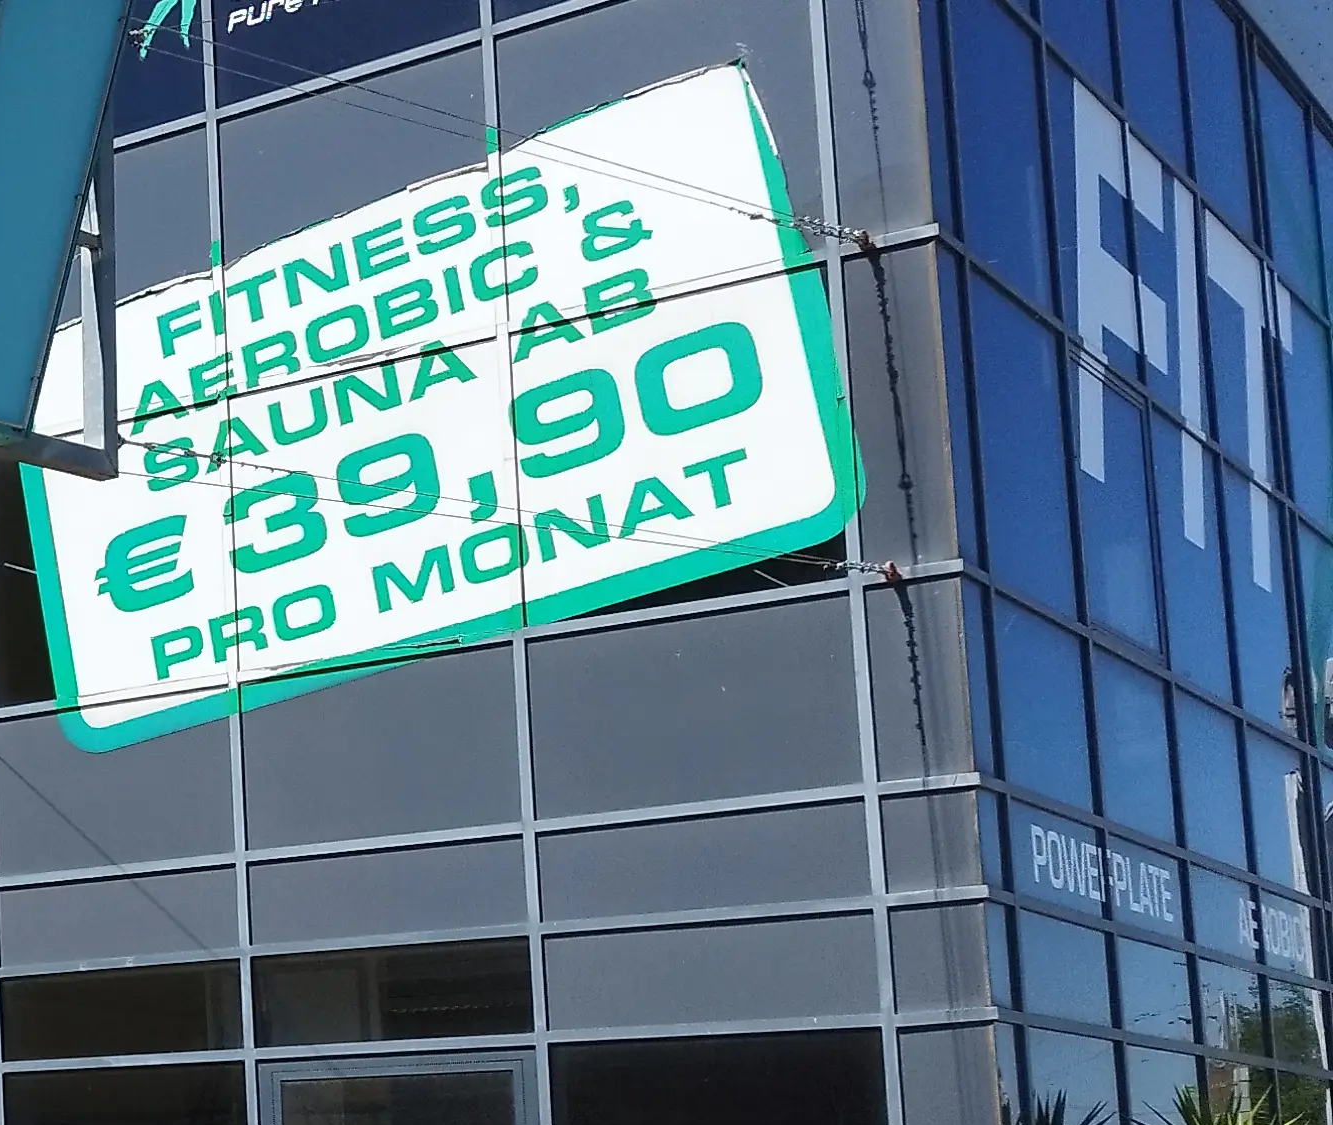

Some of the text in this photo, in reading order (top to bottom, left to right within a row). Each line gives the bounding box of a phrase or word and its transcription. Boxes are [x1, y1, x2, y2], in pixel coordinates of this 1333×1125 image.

[130, 200, 652, 436] AEROBIC &
[157, 165, 583, 358] FITNESS,
[1073, 76, 1293, 594] FIT
[94, 321, 763, 613] € 39,90
[145, 268, 657, 493] SAUNA AB
[151, 448, 749, 680] PRO MONAT
